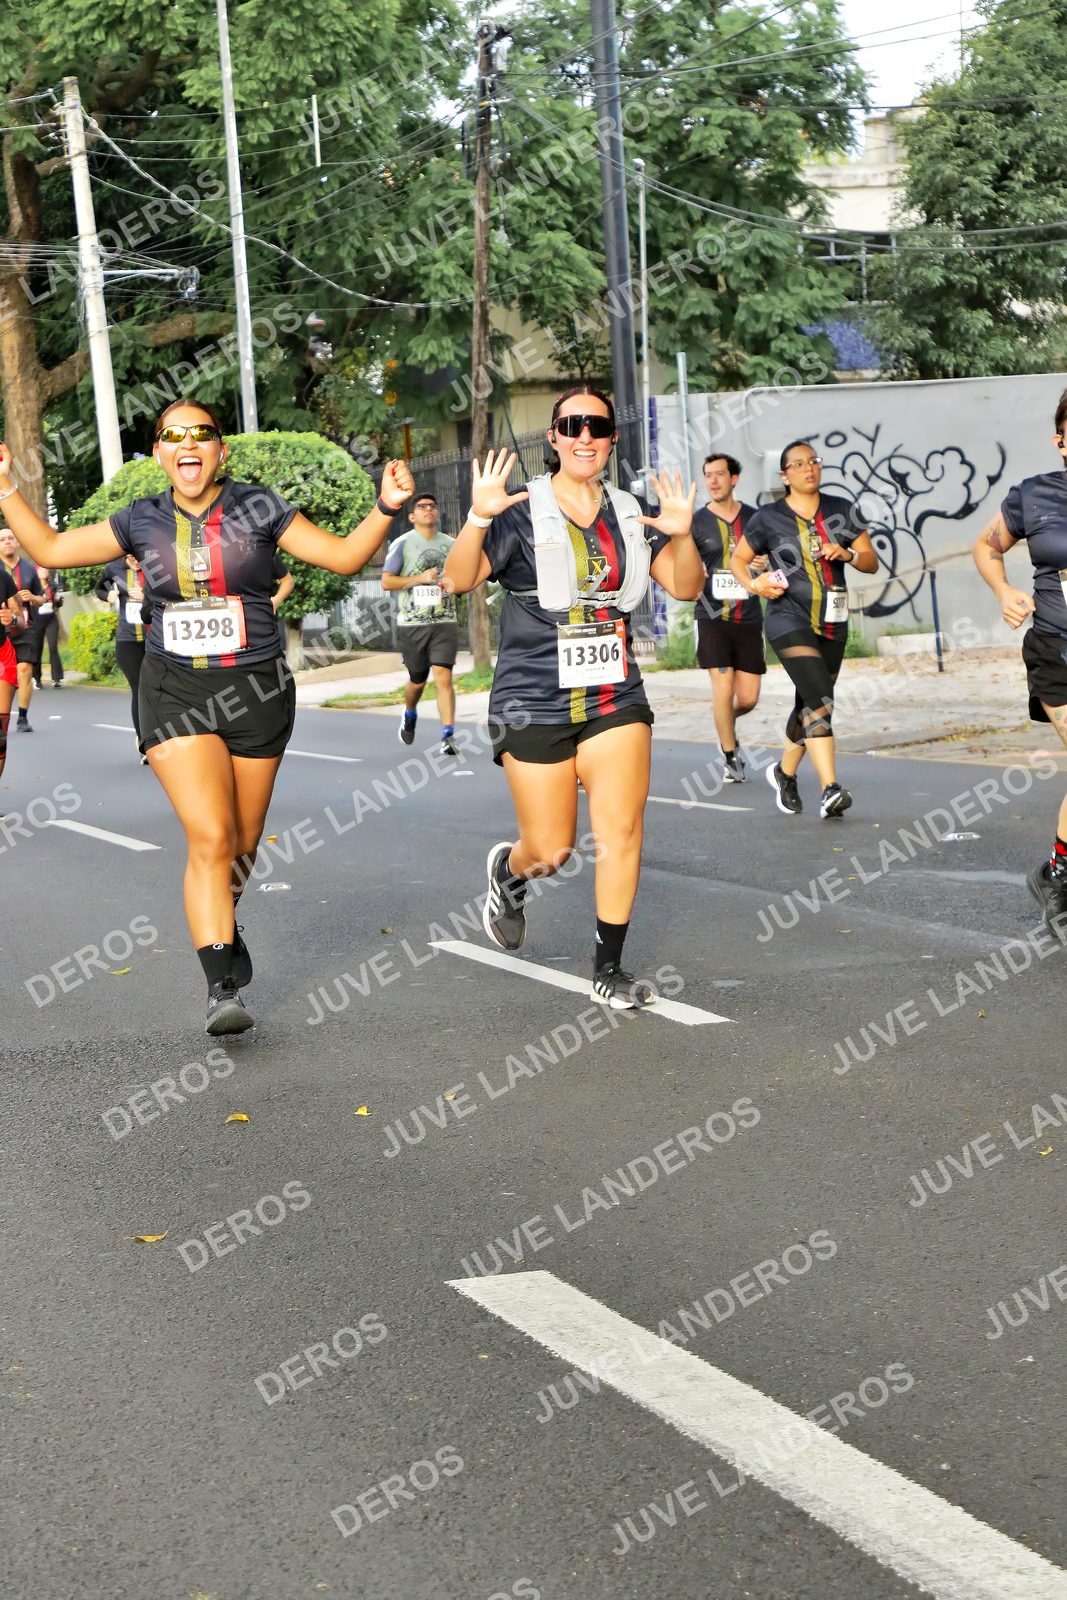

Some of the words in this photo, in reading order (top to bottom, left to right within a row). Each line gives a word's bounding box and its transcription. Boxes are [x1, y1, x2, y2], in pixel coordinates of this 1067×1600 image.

[716, 578, 743, 588] 1299
[168, 617, 234, 641] 13298
[563, 642, 620, 667] 13306
